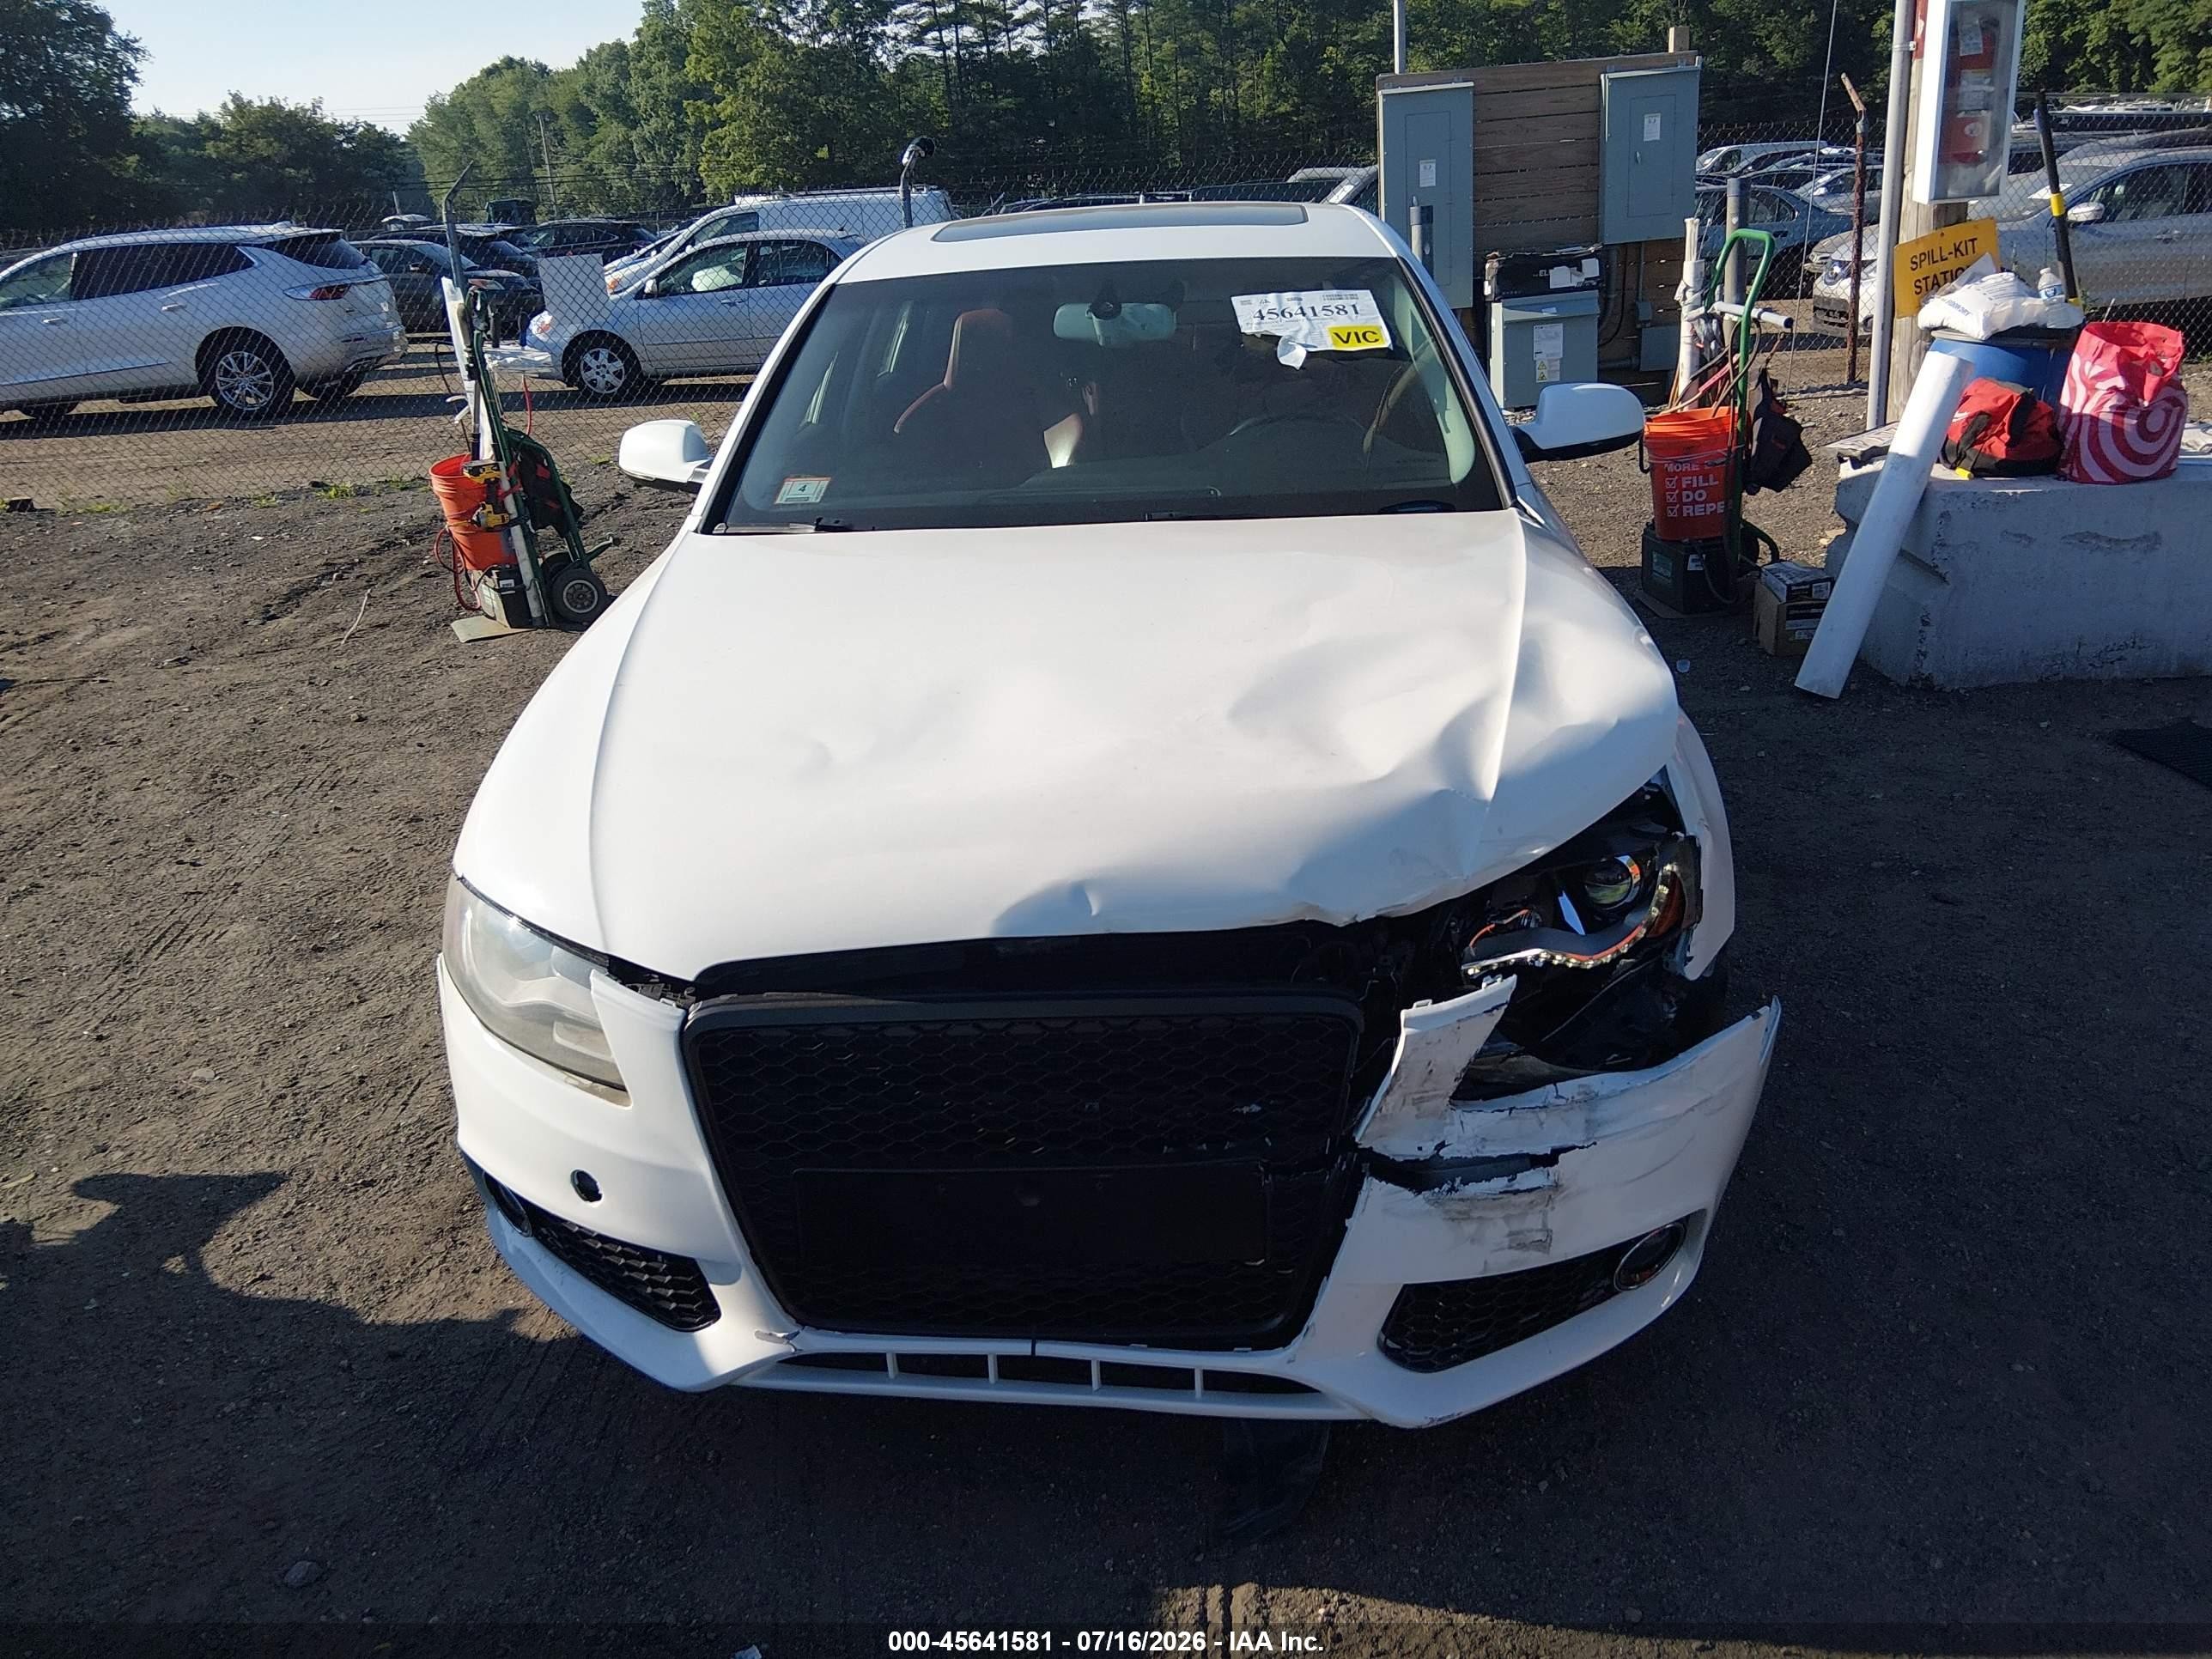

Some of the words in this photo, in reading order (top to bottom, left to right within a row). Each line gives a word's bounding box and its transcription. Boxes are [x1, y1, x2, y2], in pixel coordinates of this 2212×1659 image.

[1910, 238, 1978, 271] SPILL-KIT
[1913, 265, 1970, 295] STATIO
[1253, 304, 1359, 321] 45641581
[1332, 330, 1380, 344] VIC
[798, 484, 807, 493] 4
[1681, 474, 1719, 489] FILL
[1682, 489, 1707, 502] DO
